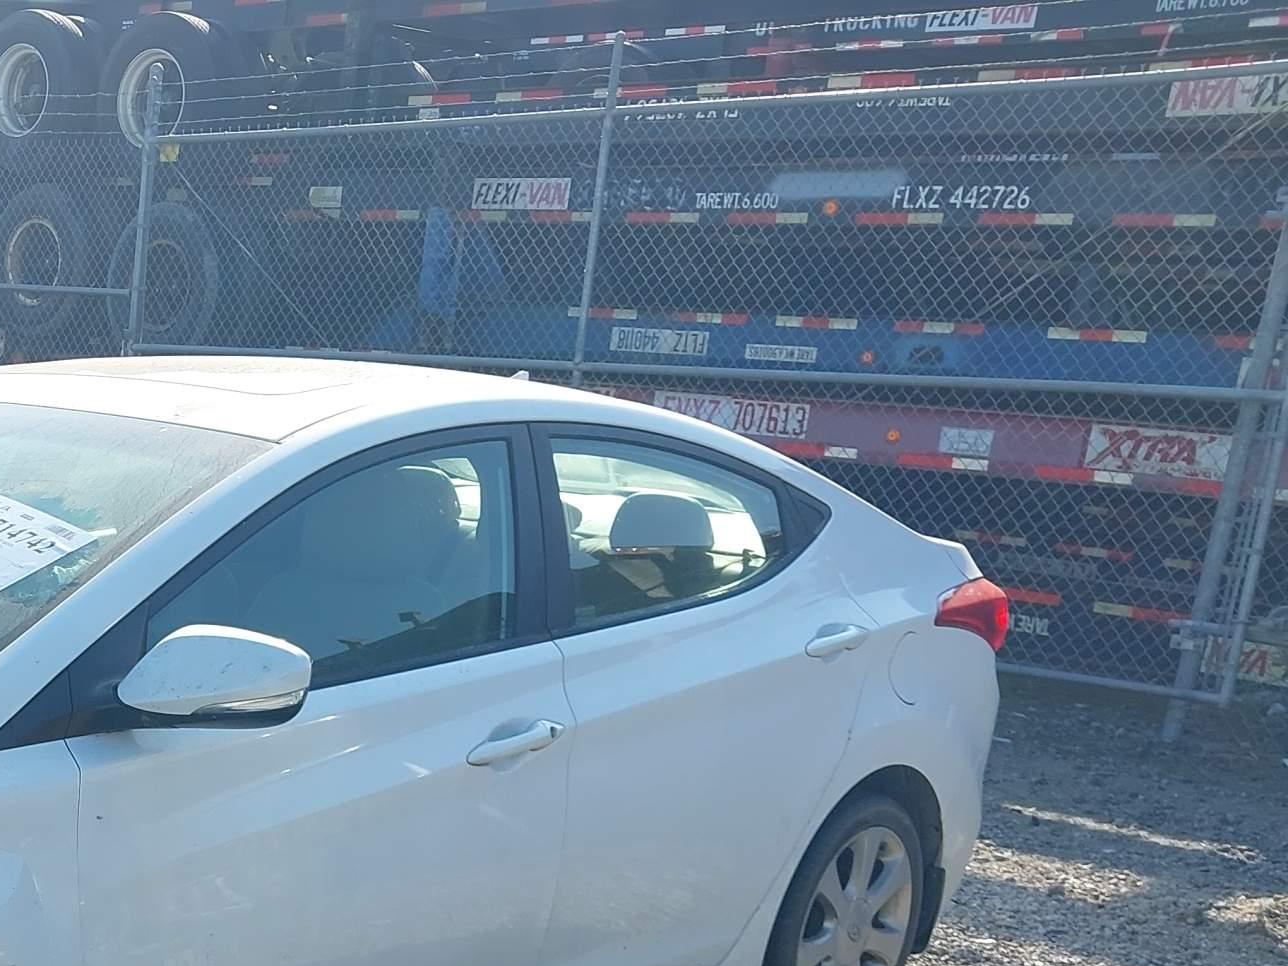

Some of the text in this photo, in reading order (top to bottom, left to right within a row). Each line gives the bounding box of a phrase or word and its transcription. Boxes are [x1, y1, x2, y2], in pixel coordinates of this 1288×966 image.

[823, 16, 919, 32] TRUCKING
[475, 182, 570, 205] FLEXI-VAN
[891, 185, 1031, 209] FLXZ 442726
[617, 329, 704, 356] FLTZ 440118
[732, 401, 807, 437] 707613
